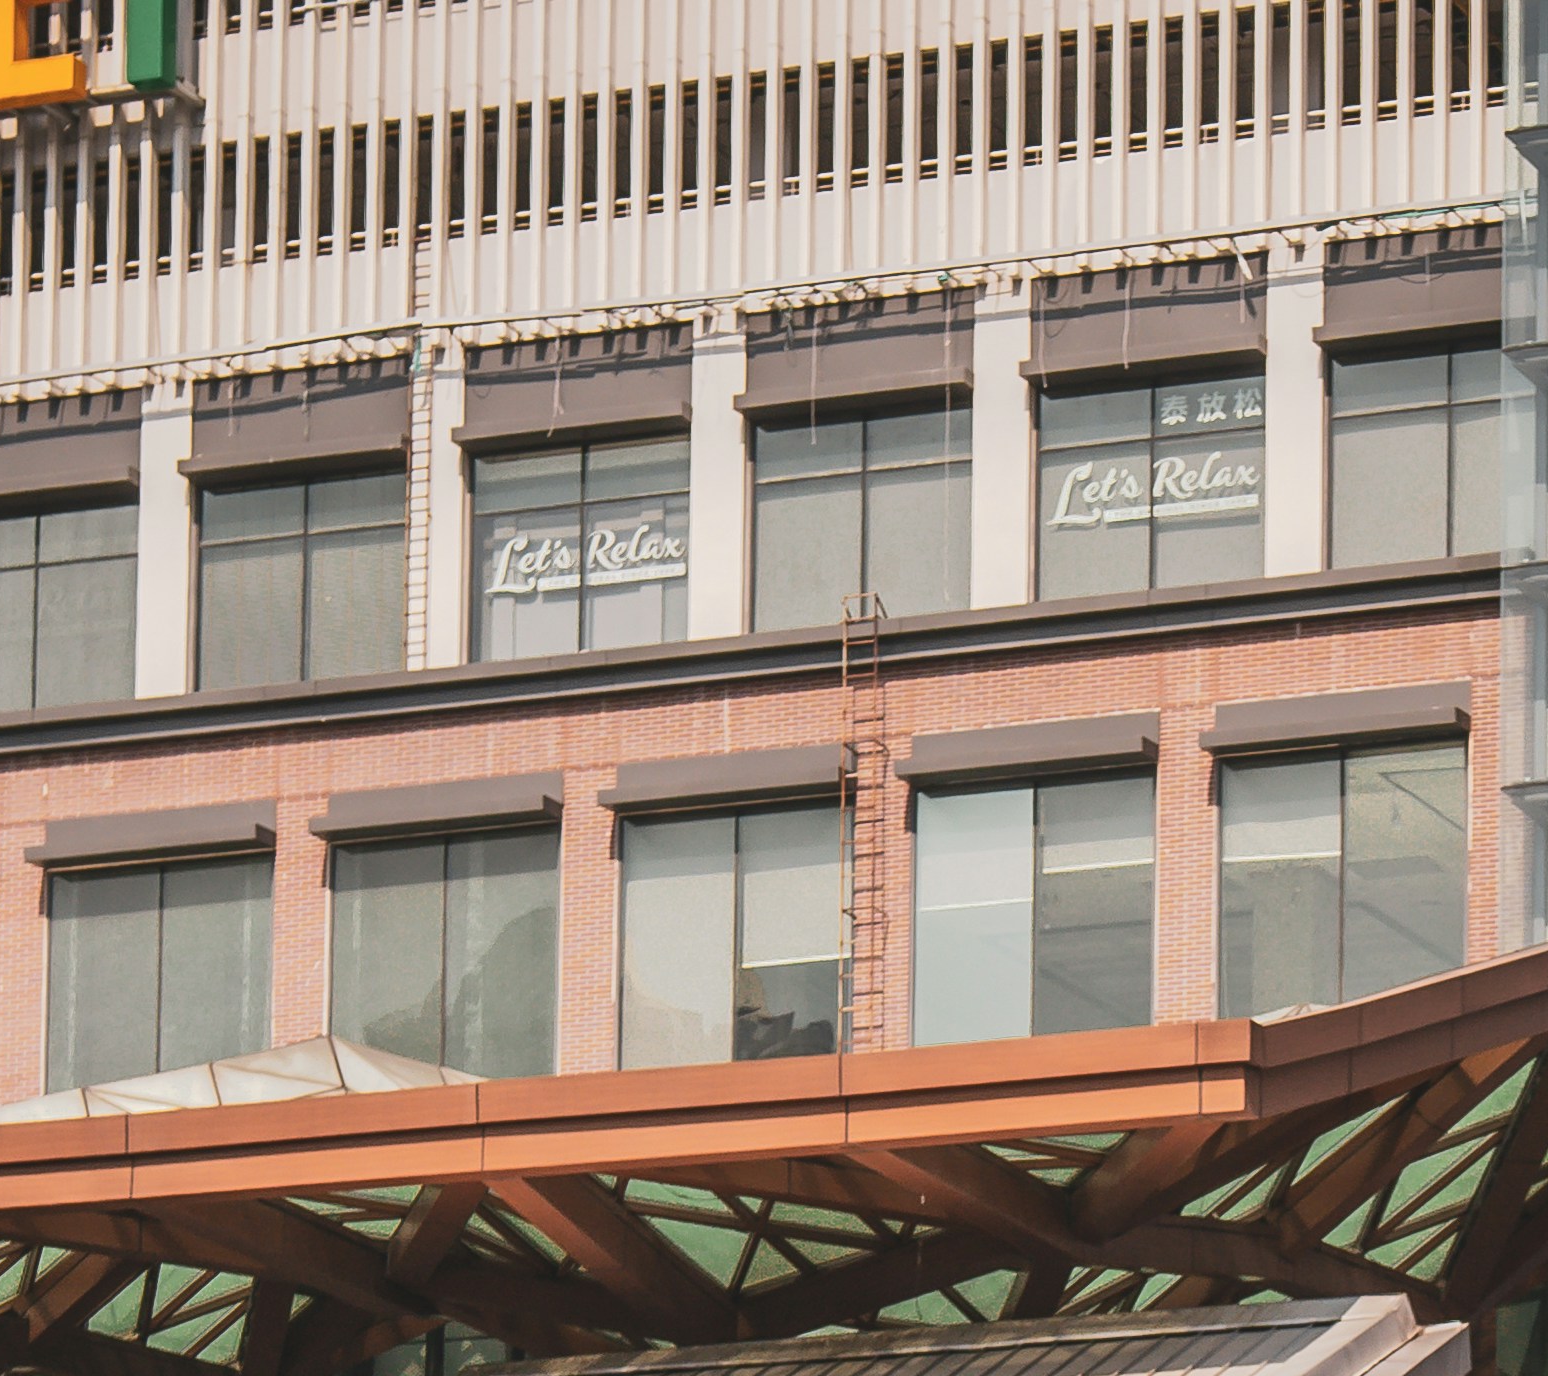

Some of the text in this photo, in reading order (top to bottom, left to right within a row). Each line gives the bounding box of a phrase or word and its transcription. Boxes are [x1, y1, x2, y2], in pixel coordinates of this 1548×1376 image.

[1046, 461, 1144, 526] Let's
[1152, 451, 1261, 500] Relax
[484, 532, 575, 594] Let's
[587, 524, 686, 570] Relax
